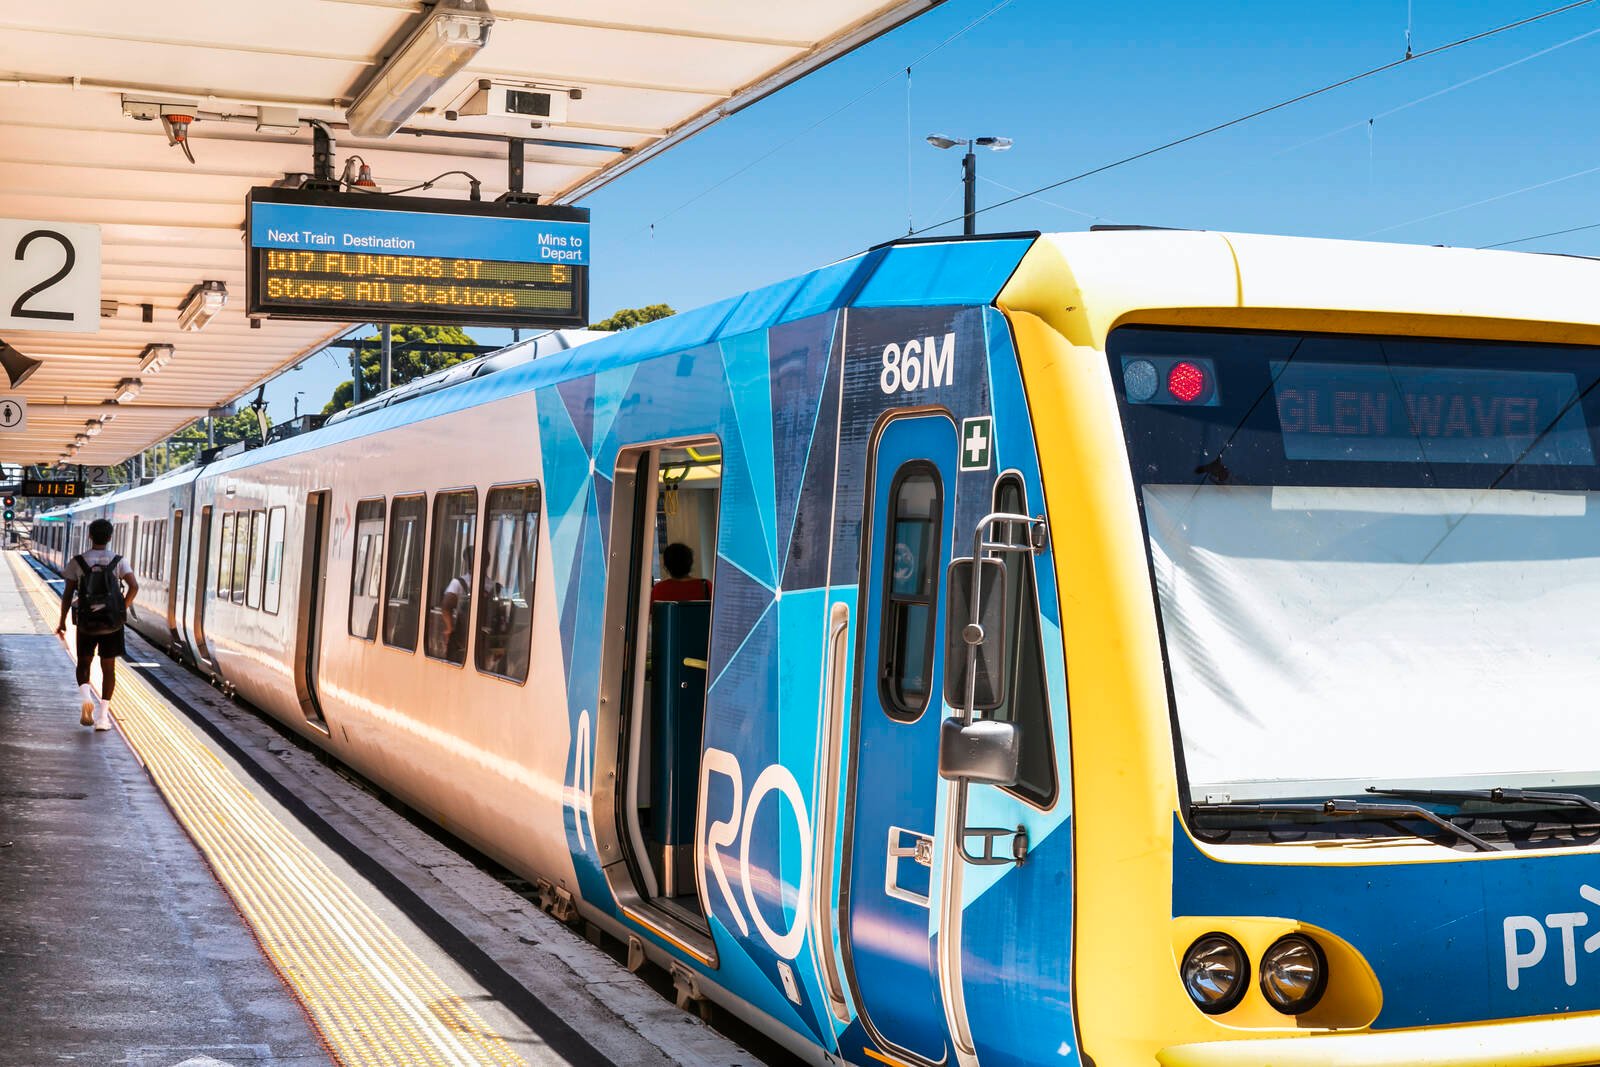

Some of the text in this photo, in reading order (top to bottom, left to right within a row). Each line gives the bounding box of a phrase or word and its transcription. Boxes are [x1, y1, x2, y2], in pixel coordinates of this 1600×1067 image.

[267, 229, 335, 245] Next Train
[343, 233, 416, 250] Destination
[537, 233, 583, 248] Mins to
[541, 246, 582, 261] Depart
[267, 250, 482, 280] 1:17 FLINDERS ST
[551, 264, 566, 283] 5
[10, 229, 76, 321] 2
[267, 277, 518, 307] Stops All Stations
[880, 332, 956, 394] 86M
[1278, 389, 1387, 434] GLEN
[92, 467, 105, 483] 2
